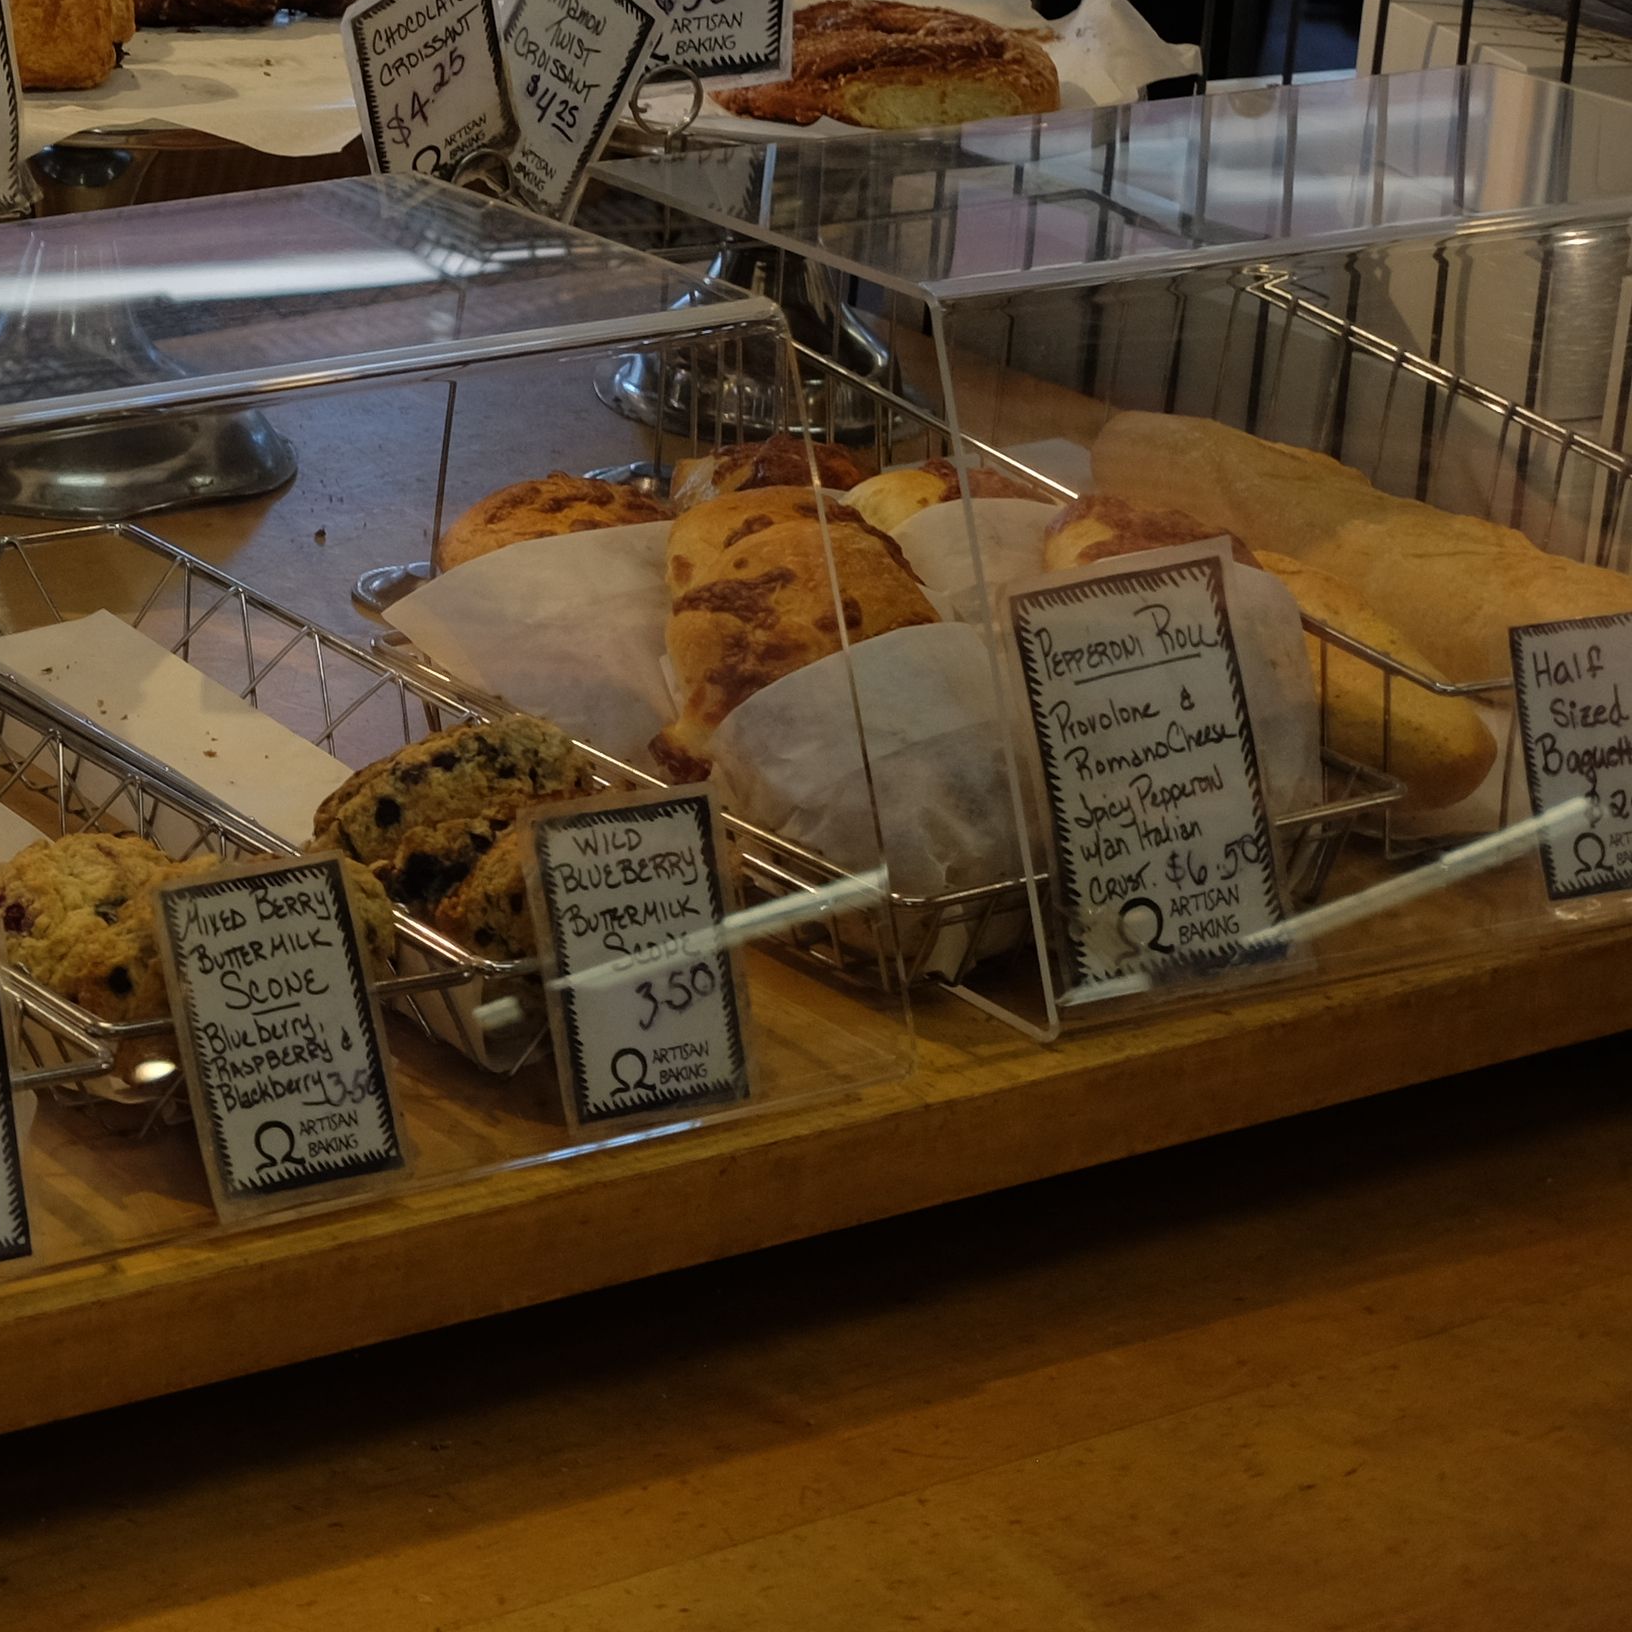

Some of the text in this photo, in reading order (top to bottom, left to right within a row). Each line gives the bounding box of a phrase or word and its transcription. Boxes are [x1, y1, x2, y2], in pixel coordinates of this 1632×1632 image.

[546, 17, 601, 61] TWIST
[671, 12, 743, 33] ARTISAN
[379, 4, 479, 87] CROISSANT
[514, 26, 600, 104] CROISSANT
[675, 36, 736, 55] BAKING
[1533, 646, 1603, 688] Half
[1049, 700, 1160, 745] Provolone
[1550, 683, 1629, 728] Sized
[1064, 721, 1236, 783] Romano Cheese
[573, 828, 643, 856] WILD
[1138, 816, 1202, 852] Italian
[183, 899, 246, 941] MIXED
[1170, 884, 1240, 917] ARTISAN
[1179, 914, 1240, 945] BAKING
[203, 1013, 325, 1056] Blueberry,
[652, 1041, 709, 1065] ARTISAN
[217, 1070, 337, 1113] Blackberry
[659, 1064, 707, 1084] BAKING
[299, 1111, 359, 1136] ARTISAN
[308, 1134, 358, 1158] BAKING
